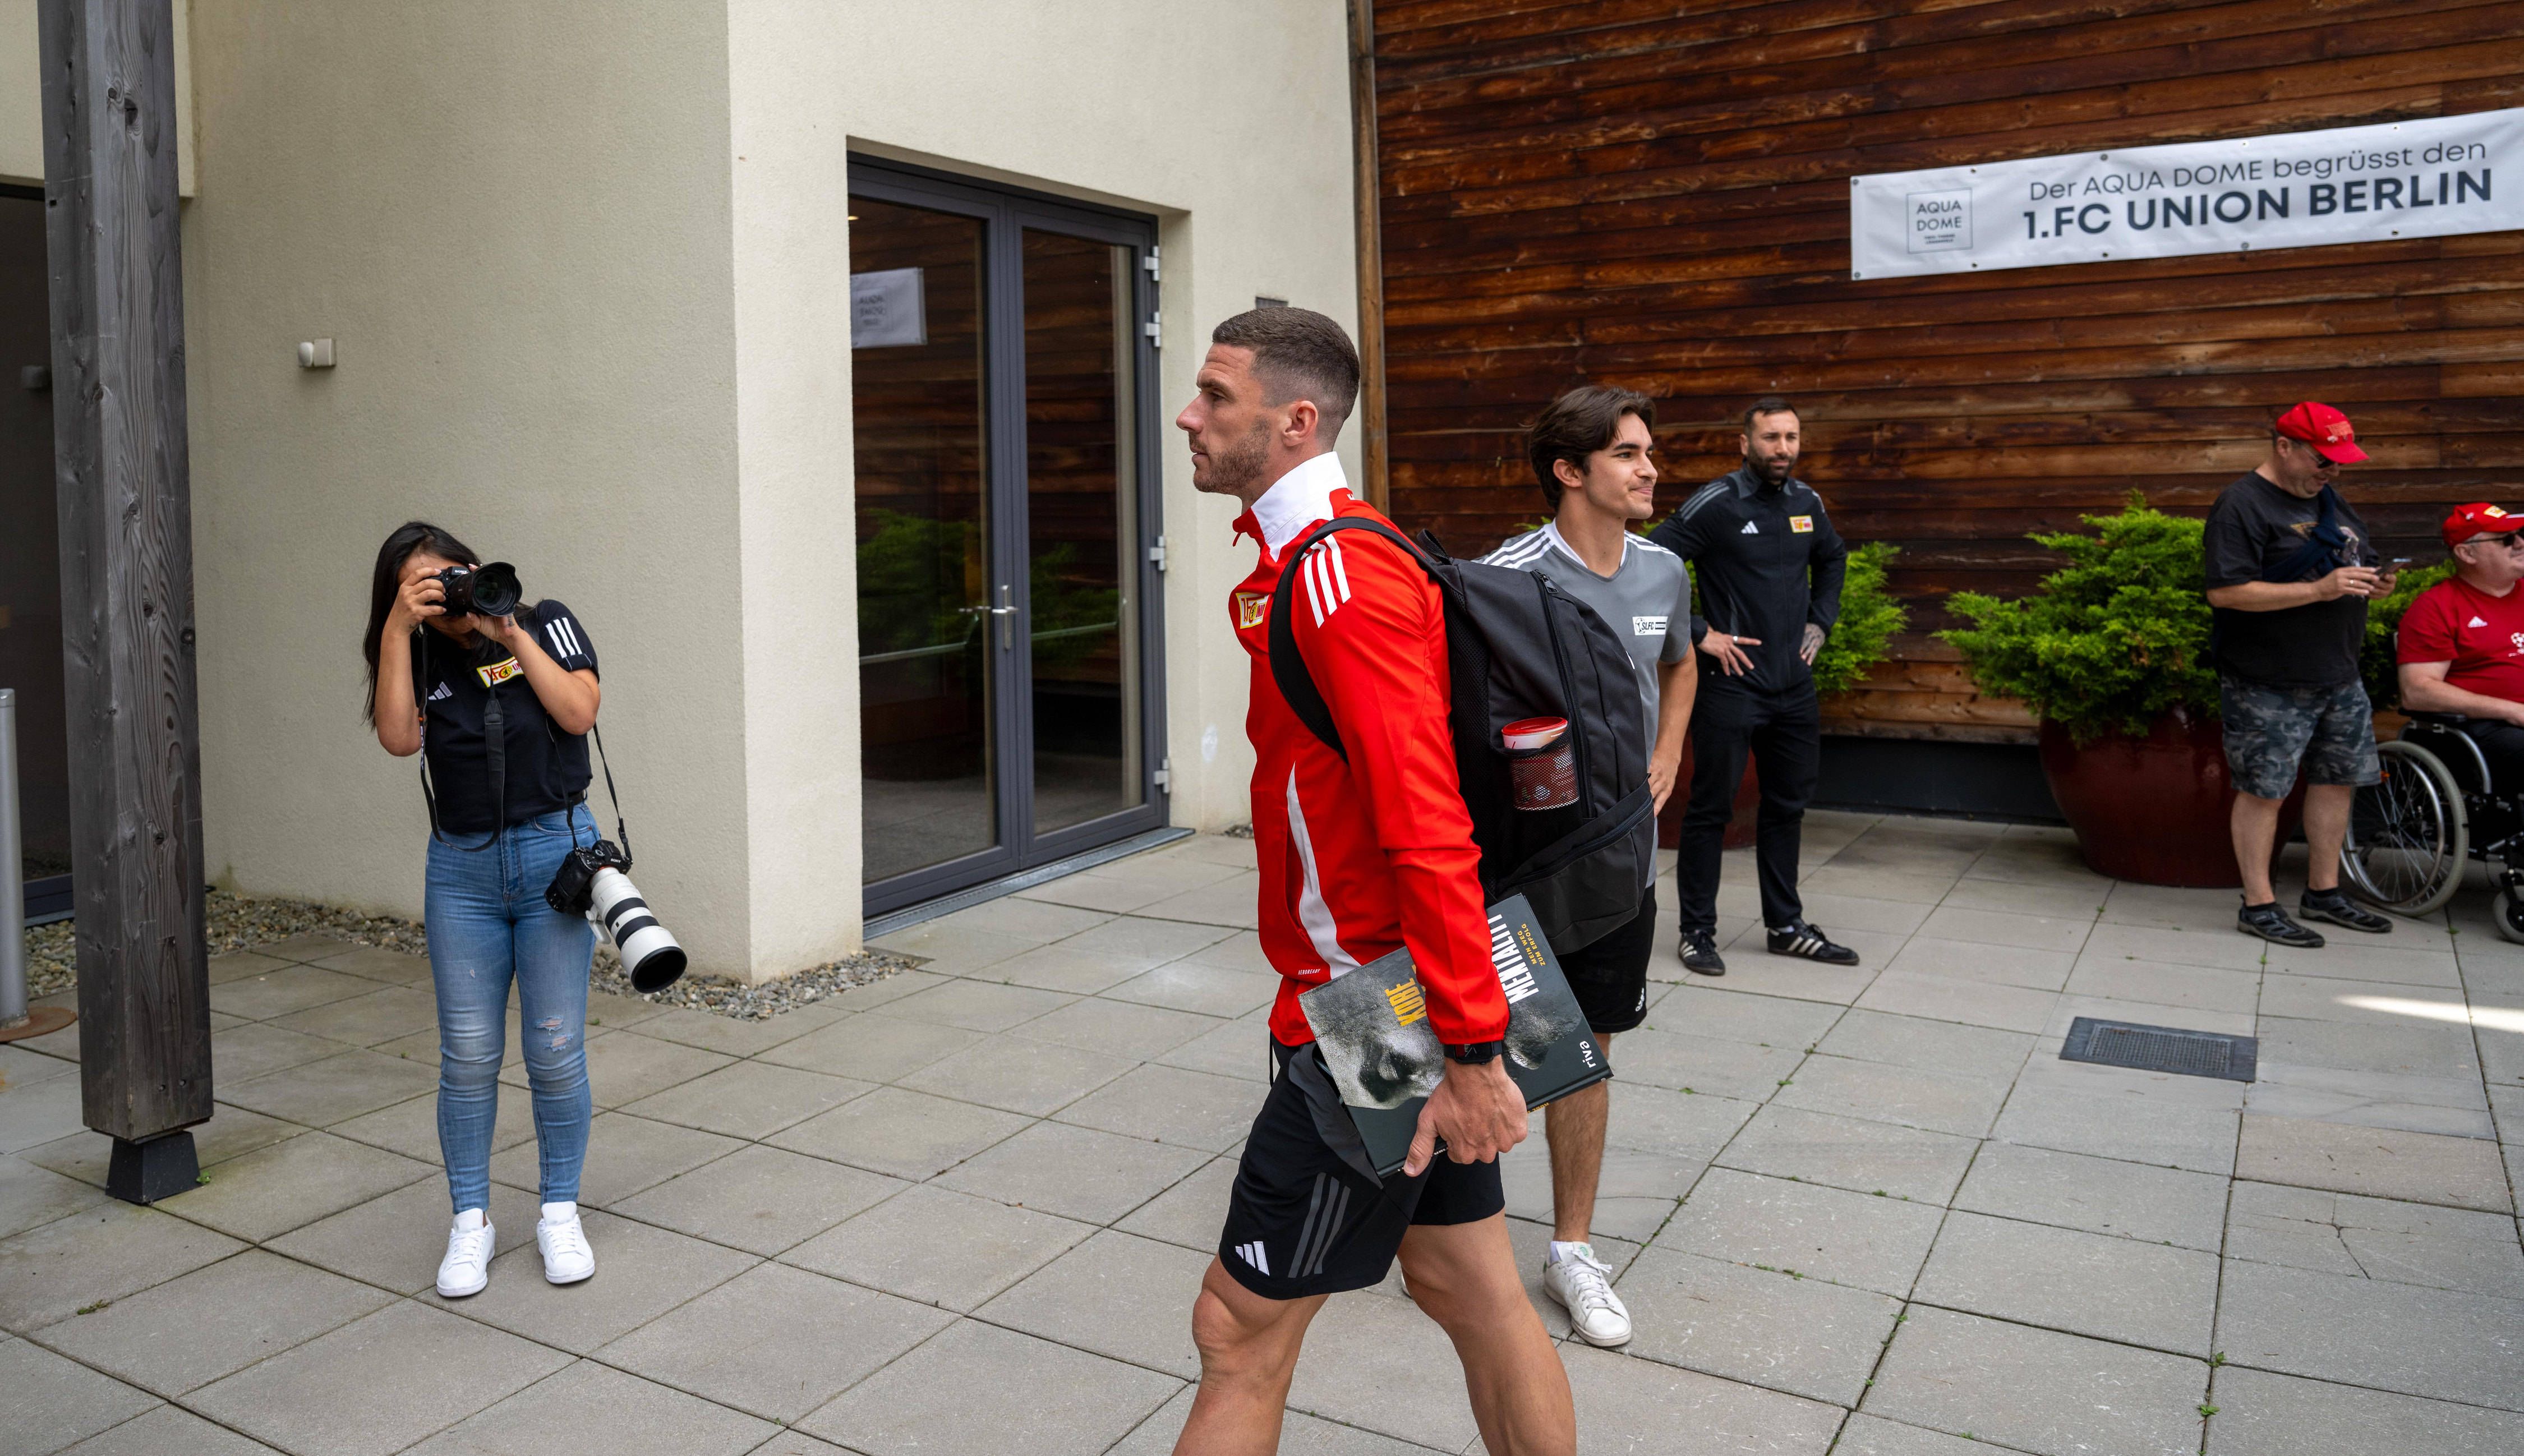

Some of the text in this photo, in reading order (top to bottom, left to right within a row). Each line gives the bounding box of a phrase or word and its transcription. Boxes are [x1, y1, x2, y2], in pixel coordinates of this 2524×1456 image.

[2030, 142, 2486, 201] Der AQUA DOME begrüsst den
[1916, 200, 1962, 214] AQUA
[2023, 168, 2491, 239] 1.FC UNION BERLIN
[1917, 216, 1962, 231] DOME
[1517, 930, 1537, 965] MEIN WEG
[1521, 923, 1546, 966] ZUM ERFOLG
[1385, 978, 1427, 1027] KOBE
[1579, 1040, 1597, 1068] riva
